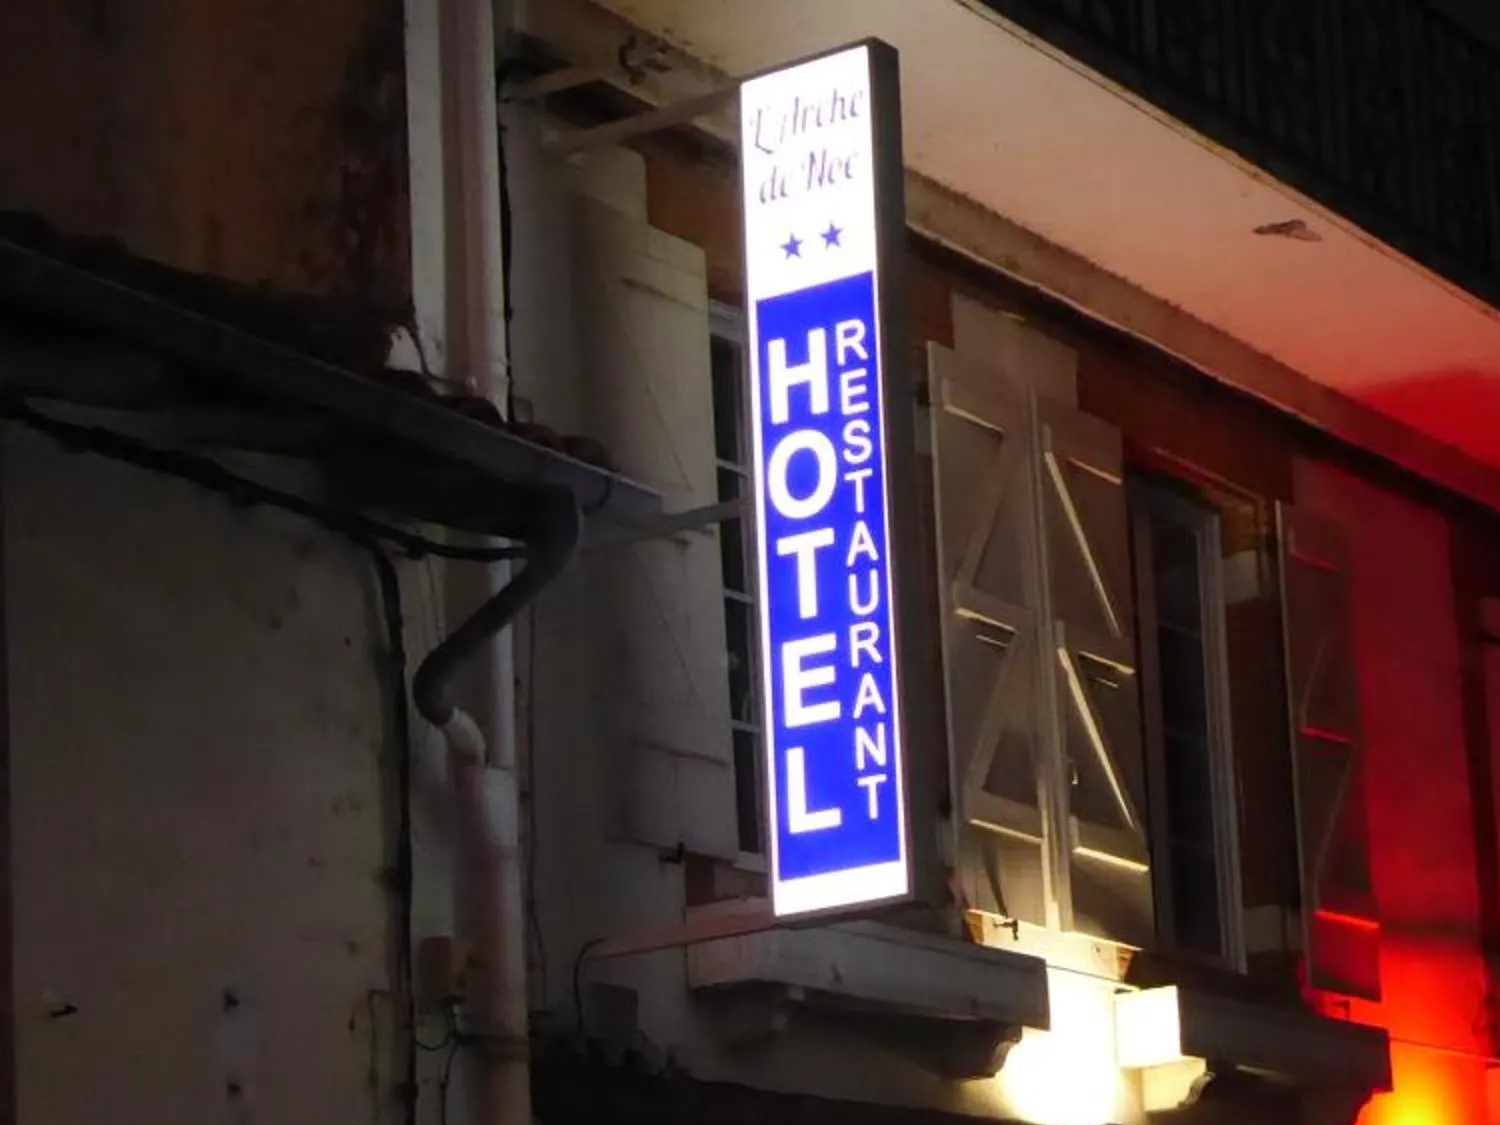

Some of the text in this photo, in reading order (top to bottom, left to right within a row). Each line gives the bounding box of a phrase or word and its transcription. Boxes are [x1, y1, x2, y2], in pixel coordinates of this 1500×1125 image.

[758, 164, 792, 206] de
[767, 327, 842, 835] HOTEL
[835, 318, 888, 820] RESTAURANT
